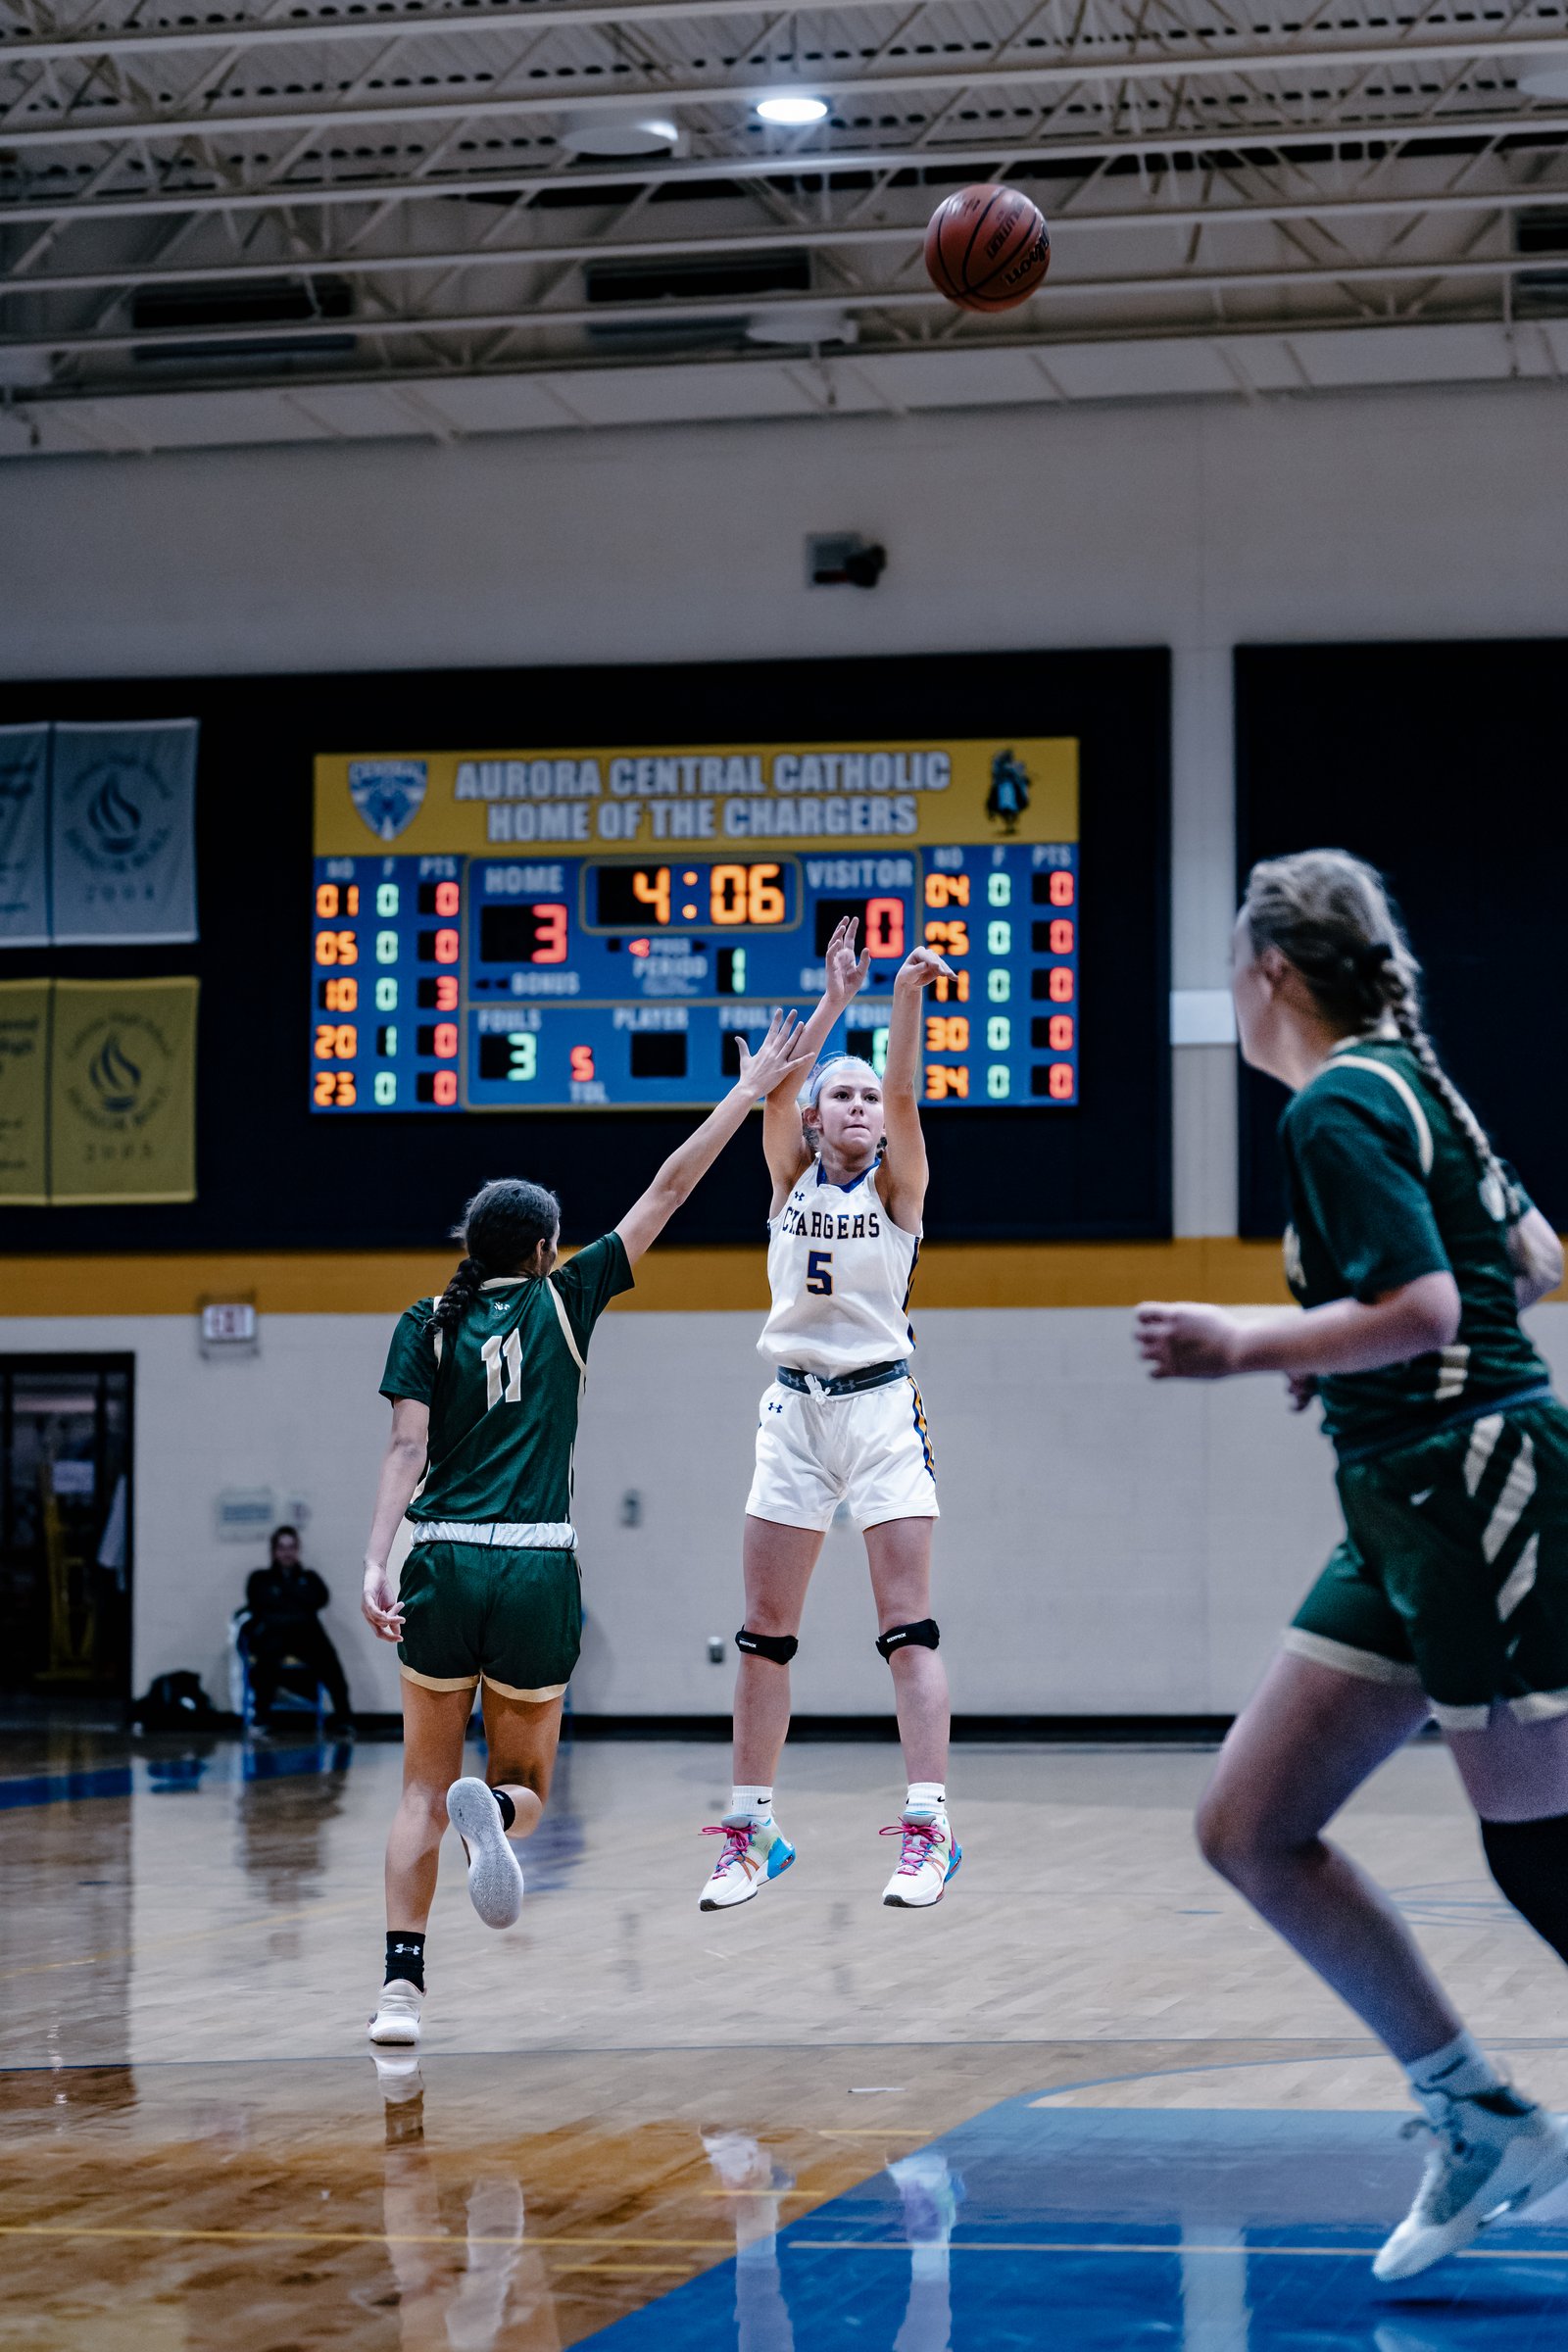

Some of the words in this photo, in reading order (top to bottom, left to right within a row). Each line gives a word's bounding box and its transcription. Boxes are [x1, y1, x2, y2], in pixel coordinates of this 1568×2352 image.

[455, 759, 603, 801] AURORA
[610, 755, 767, 797] CENTRAL
[772, 751, 952, 794] CATHOLIC
[487, 802, 590, 843] HOME
[598, 800, 643, 841] OF
[650, 798, 716, 840] THE
[723, 794, 919, 837] CHARGERS
[485, 865, 564, 896] HOME
[806, 858, 914, 890] VISITOR
[925, 873, 969, 907] 04
[987, 872, 1011, 907] 0
[1050, 871, 1074, 906] 0
[316, 884, 360, 918] 01
[376, 883, 400, 917] 0
[435, 882, 460, 917] 0
[633, 863, 785, 925] 4:06
[532, 904, 567, 963] 3
[866, 898, 904, 957] 0
[987, 920, 1011, 956] 0
[1050, 919, 1074, 955] 0
[315, 931, 359, 965] 05
[375, 930, 399, 964] 0
[435, 929, 459, 964] 0
[512, 971, 581, 997] BONUS
[632, 955, 709, 979] PERIOD
[732, 948, 746, 993] 1
[1049, 966, 1074, 1003] 0
[375, 977, 398, 1011] 0
[436, 975, 459, 1011] 3
[987, 968, 1010, 1003] 0
[477, 1008, 542, 1033] FOULS
[612, 1006, 689, 1032] PLAYER
[926, 1016, 969, 1052] 30
[987, 1015, 1010, 1052] 0
[1049, 1014, 1073, 1052] 0
[314, 1024, 358, 1059] 20
[385, 1025, 398, 1057] 1
[434, 1022, 458, 1058] 0
[508, 1032, 537, 1082] 3
[569, 1046, 595, 1082] 5
[926, 1064, 968, 1100] 34
[987, 1064, 1010, 1100] 0
[1049, 1062, 1073, 1100] 0
[314, 1071, 357, 1106] 25
[374, 1071, 397, 1105] 0
[433, 1070, 458, 1106] 0
[806, 1250, 834, 1297] 5
[481, 1327, 523, 1412] 11
